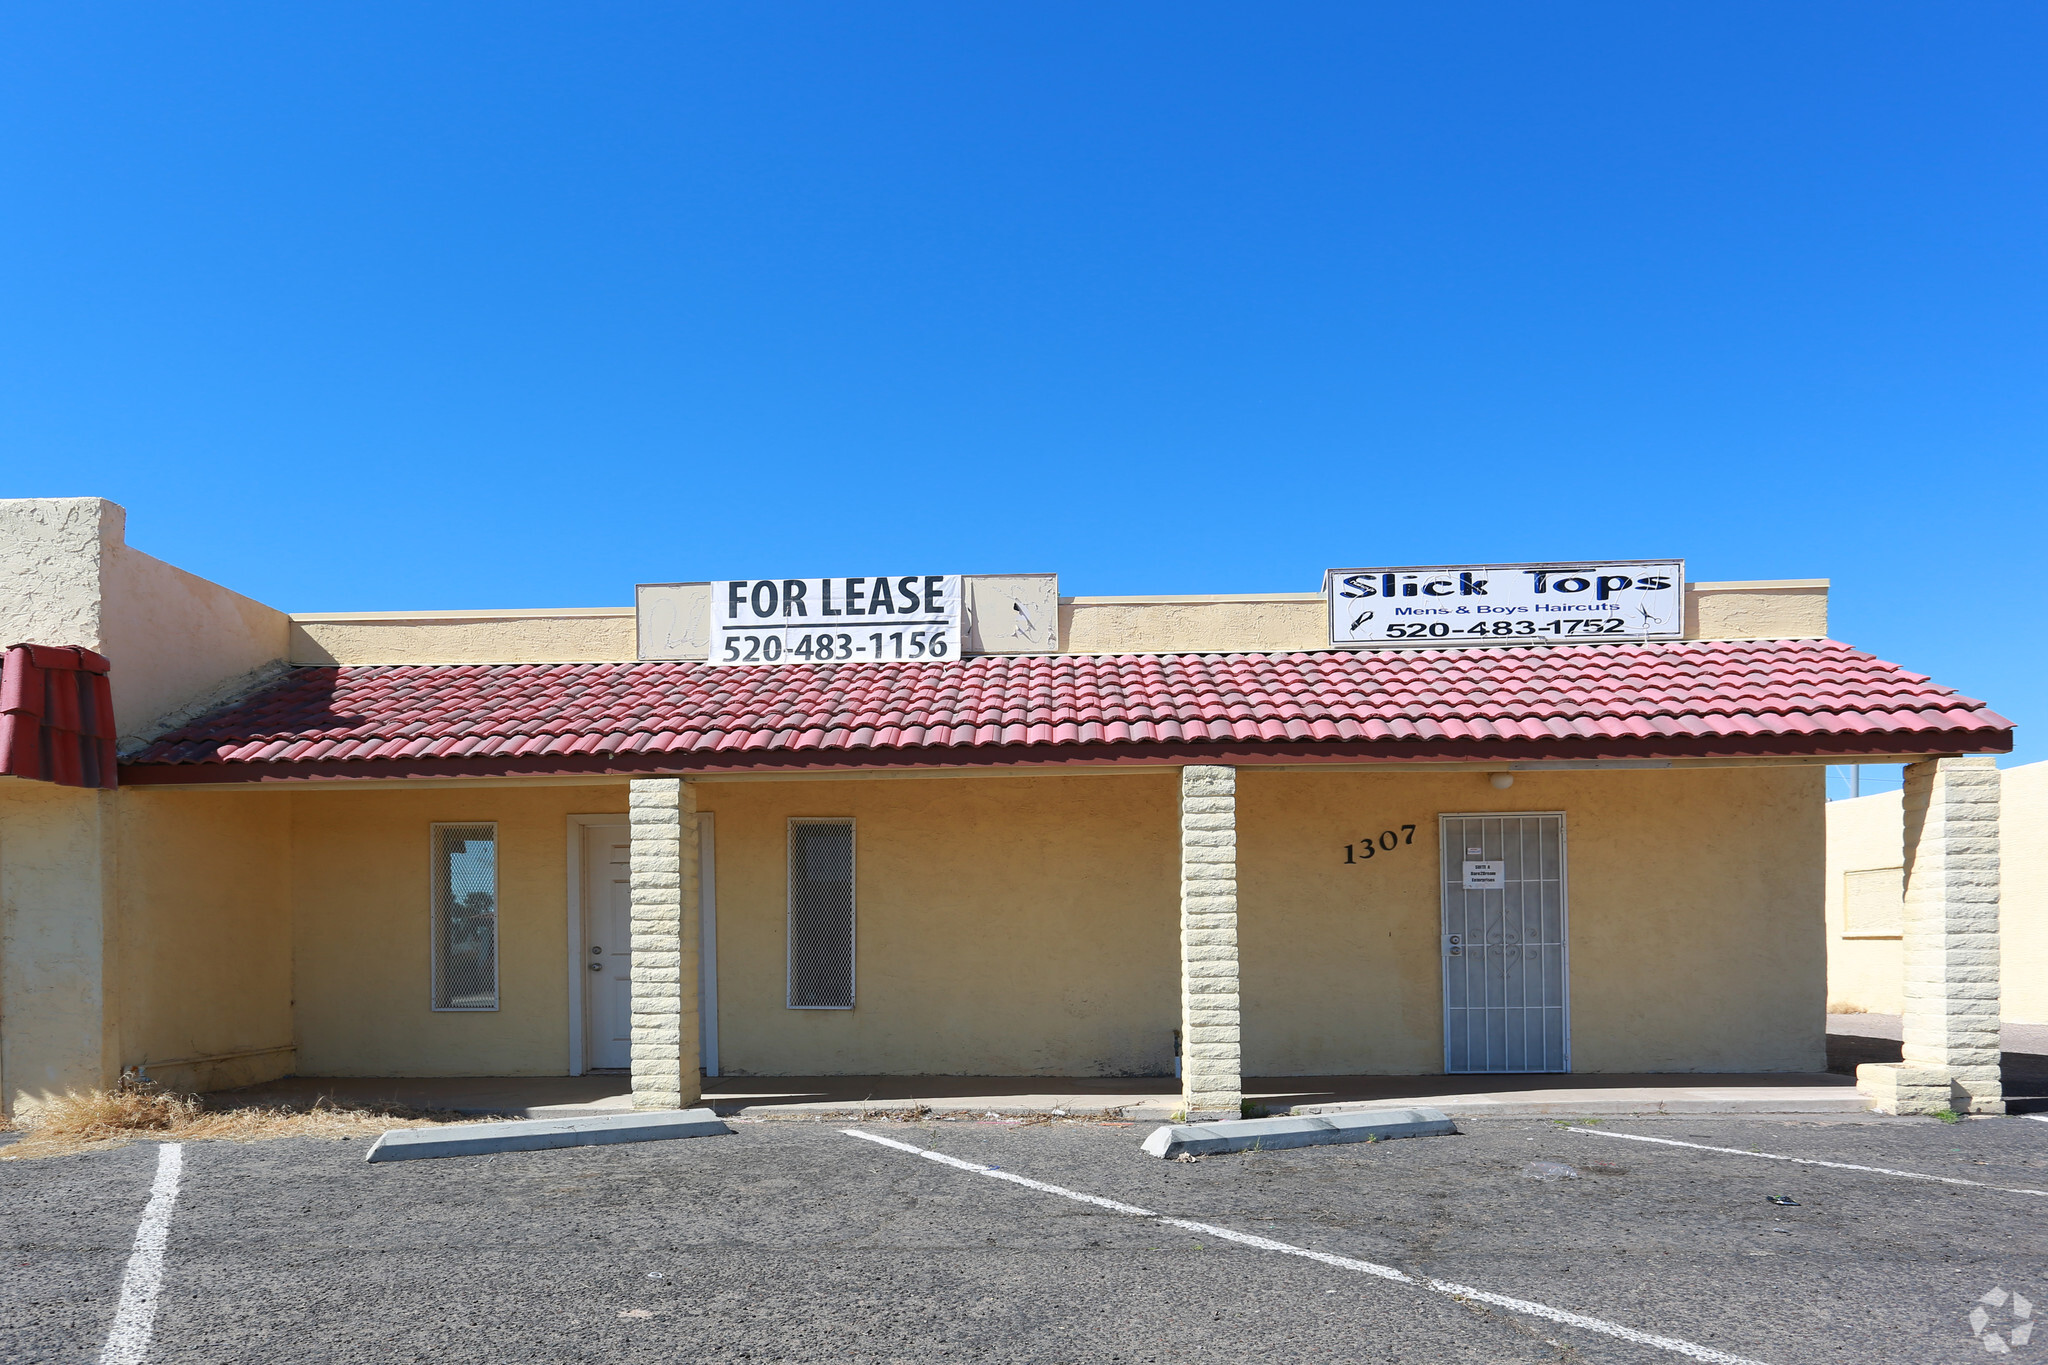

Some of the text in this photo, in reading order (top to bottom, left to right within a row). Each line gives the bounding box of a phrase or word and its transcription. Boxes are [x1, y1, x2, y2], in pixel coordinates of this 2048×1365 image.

[728, 575, 945, 619] FOR LEASE
[1339, 568, 1672, 601] Slick Tops
[1395, 602, 1621, 616] Mens & Boys Haircuts
[1385, 618, 1625, 639] 520-483-1752
[722, 632, 948, 662] 520-483-1156
[1343, 824, 1416, 865] 1307
